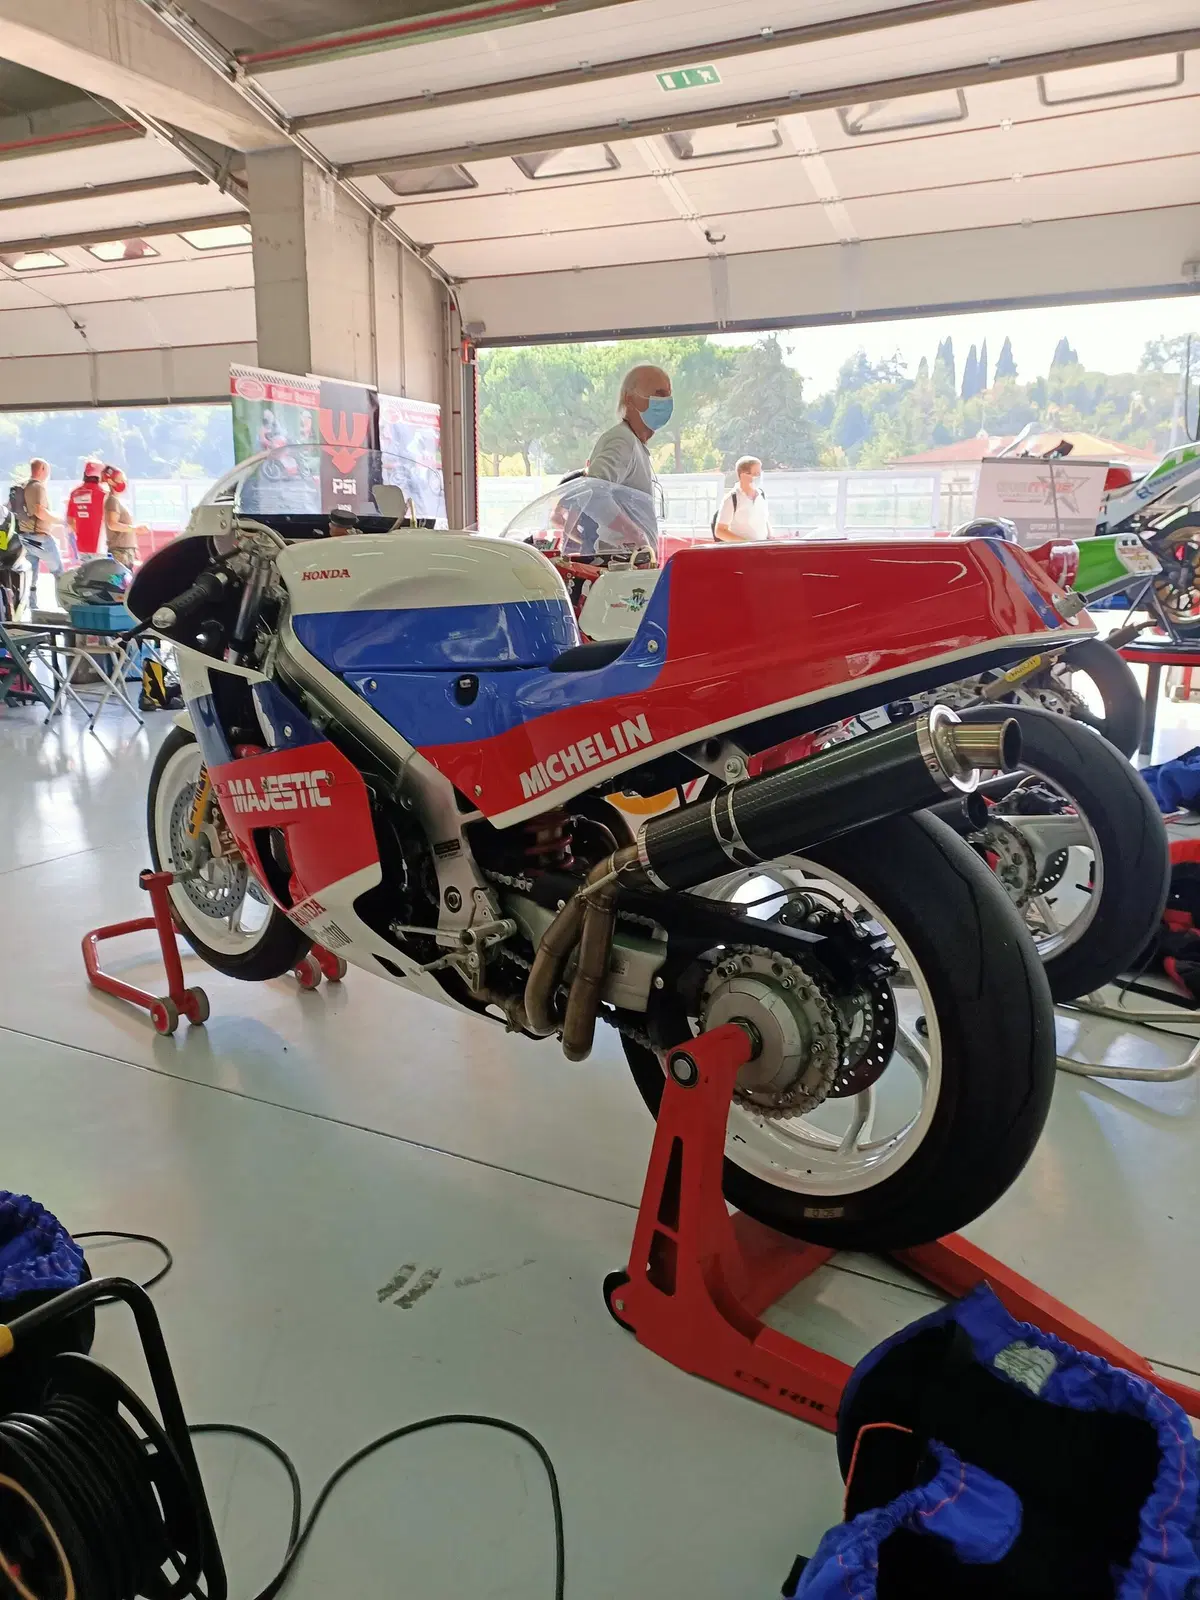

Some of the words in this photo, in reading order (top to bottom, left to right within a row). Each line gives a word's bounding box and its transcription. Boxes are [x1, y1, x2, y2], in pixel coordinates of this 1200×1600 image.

[301, 569, 351, 582] HONDA
[518, 713, 653, 800] MICHELIN
[228, 769, 331, 813] MAJESTIC
[290, 898, 327, 927] HONDA
